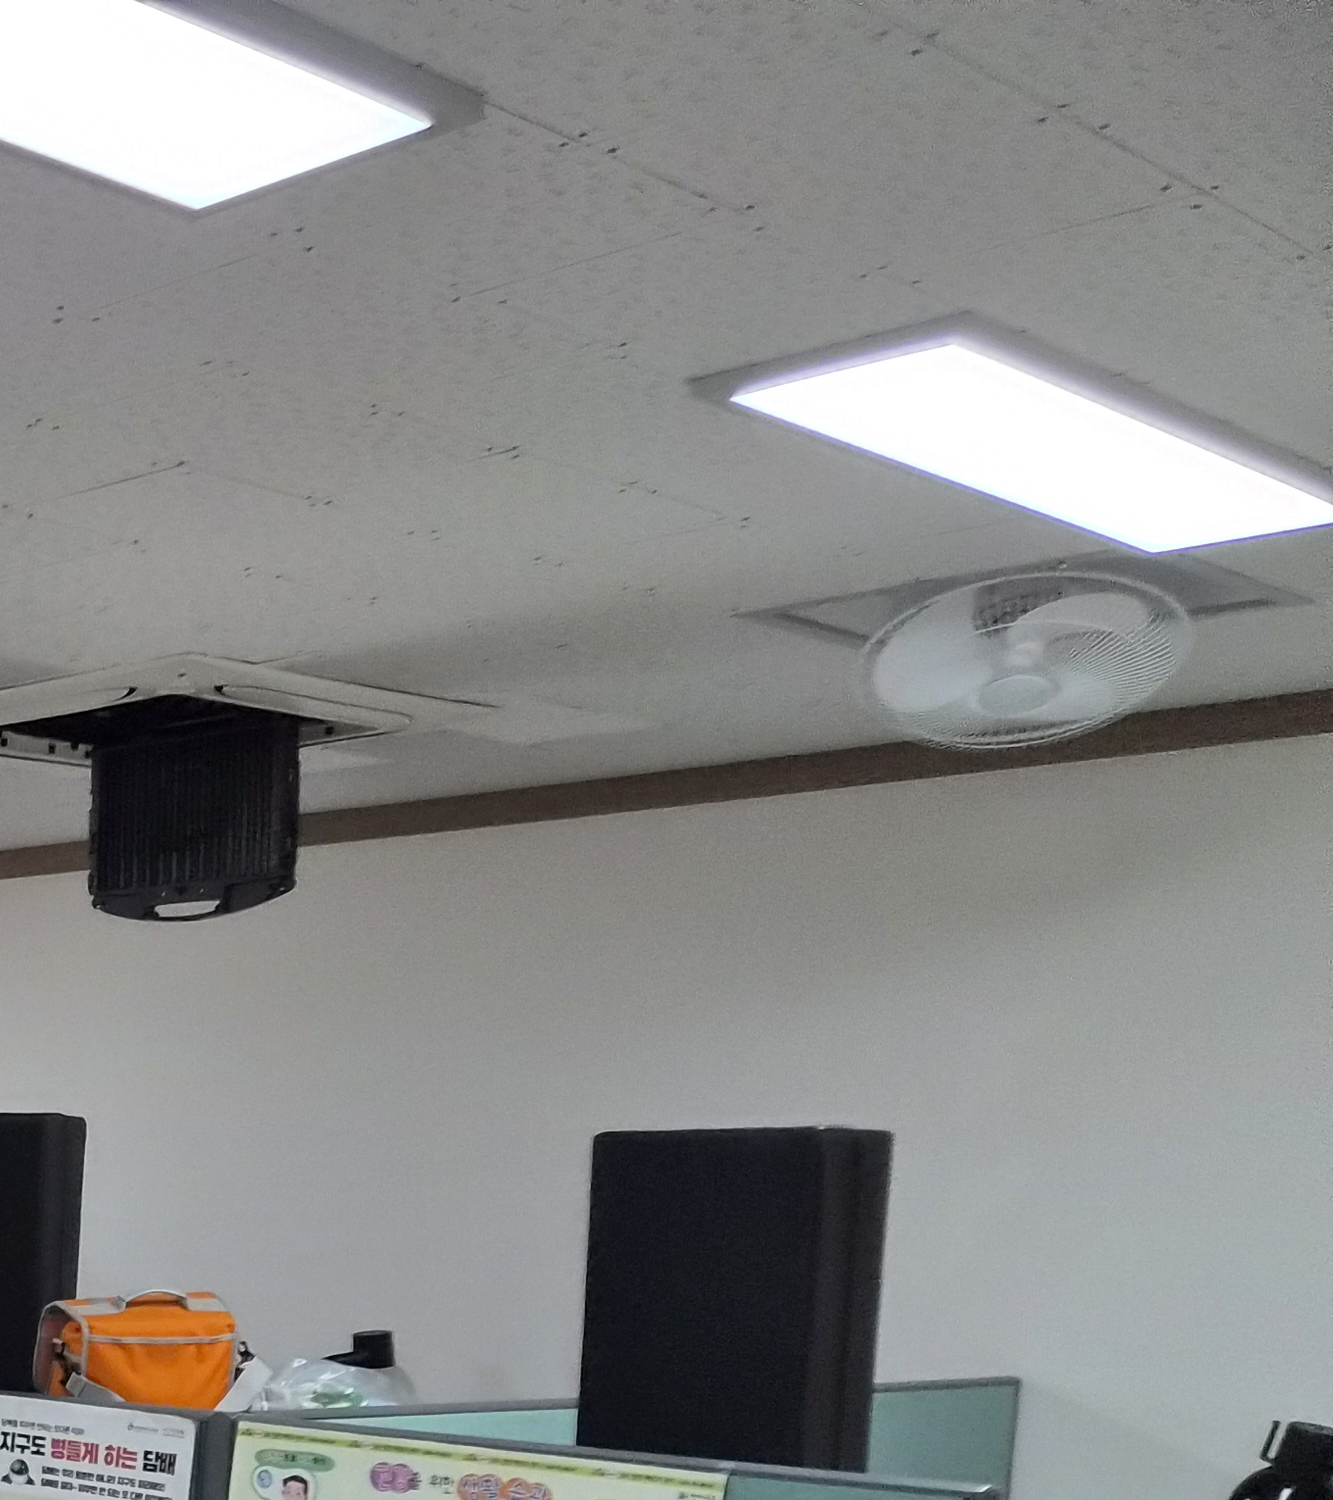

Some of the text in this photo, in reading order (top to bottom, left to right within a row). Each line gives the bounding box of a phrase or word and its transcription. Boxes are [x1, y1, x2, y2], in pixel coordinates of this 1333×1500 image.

[0, 1431, 177, 1476] 지구도 병들게 하는 담배
